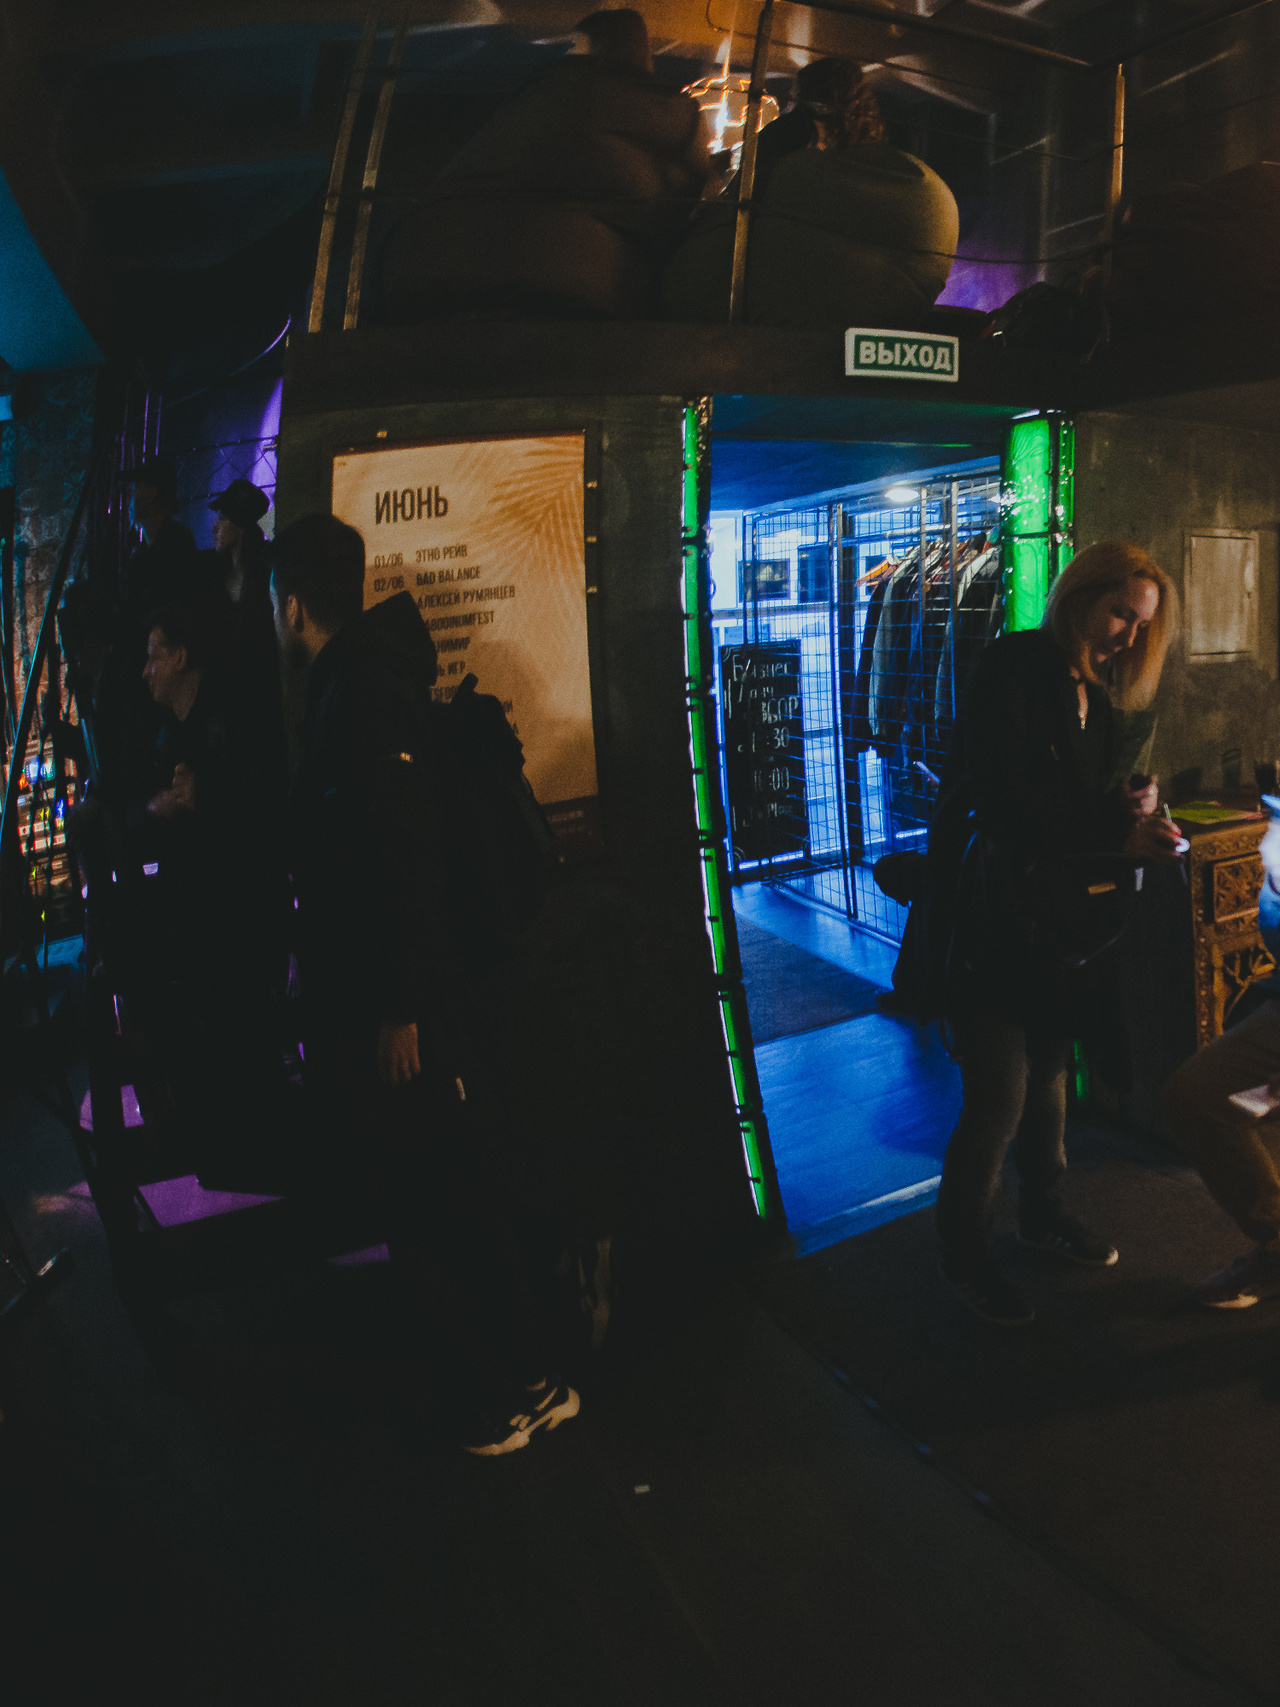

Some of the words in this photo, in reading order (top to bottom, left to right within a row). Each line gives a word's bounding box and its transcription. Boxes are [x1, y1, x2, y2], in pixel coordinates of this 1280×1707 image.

[859, 341, 952, 371] ВЫХОД
[375, 485, 449, 525] ИЮНЬ
[374, 552, 404, 569] 01/06
[416, 547, 440, 563] ЭТНО
[443, 543, 468, 560] РЕЙВ
[373, 575, 405, 592] 02/06
[416, 570, 435, 586] BAD
[438, 565, 481, 584] BALANCE
[417, 588, 460, 609] АЛЕКСЕЙ
[463, 584, 516, 604] РУМЯНЦЕВ
